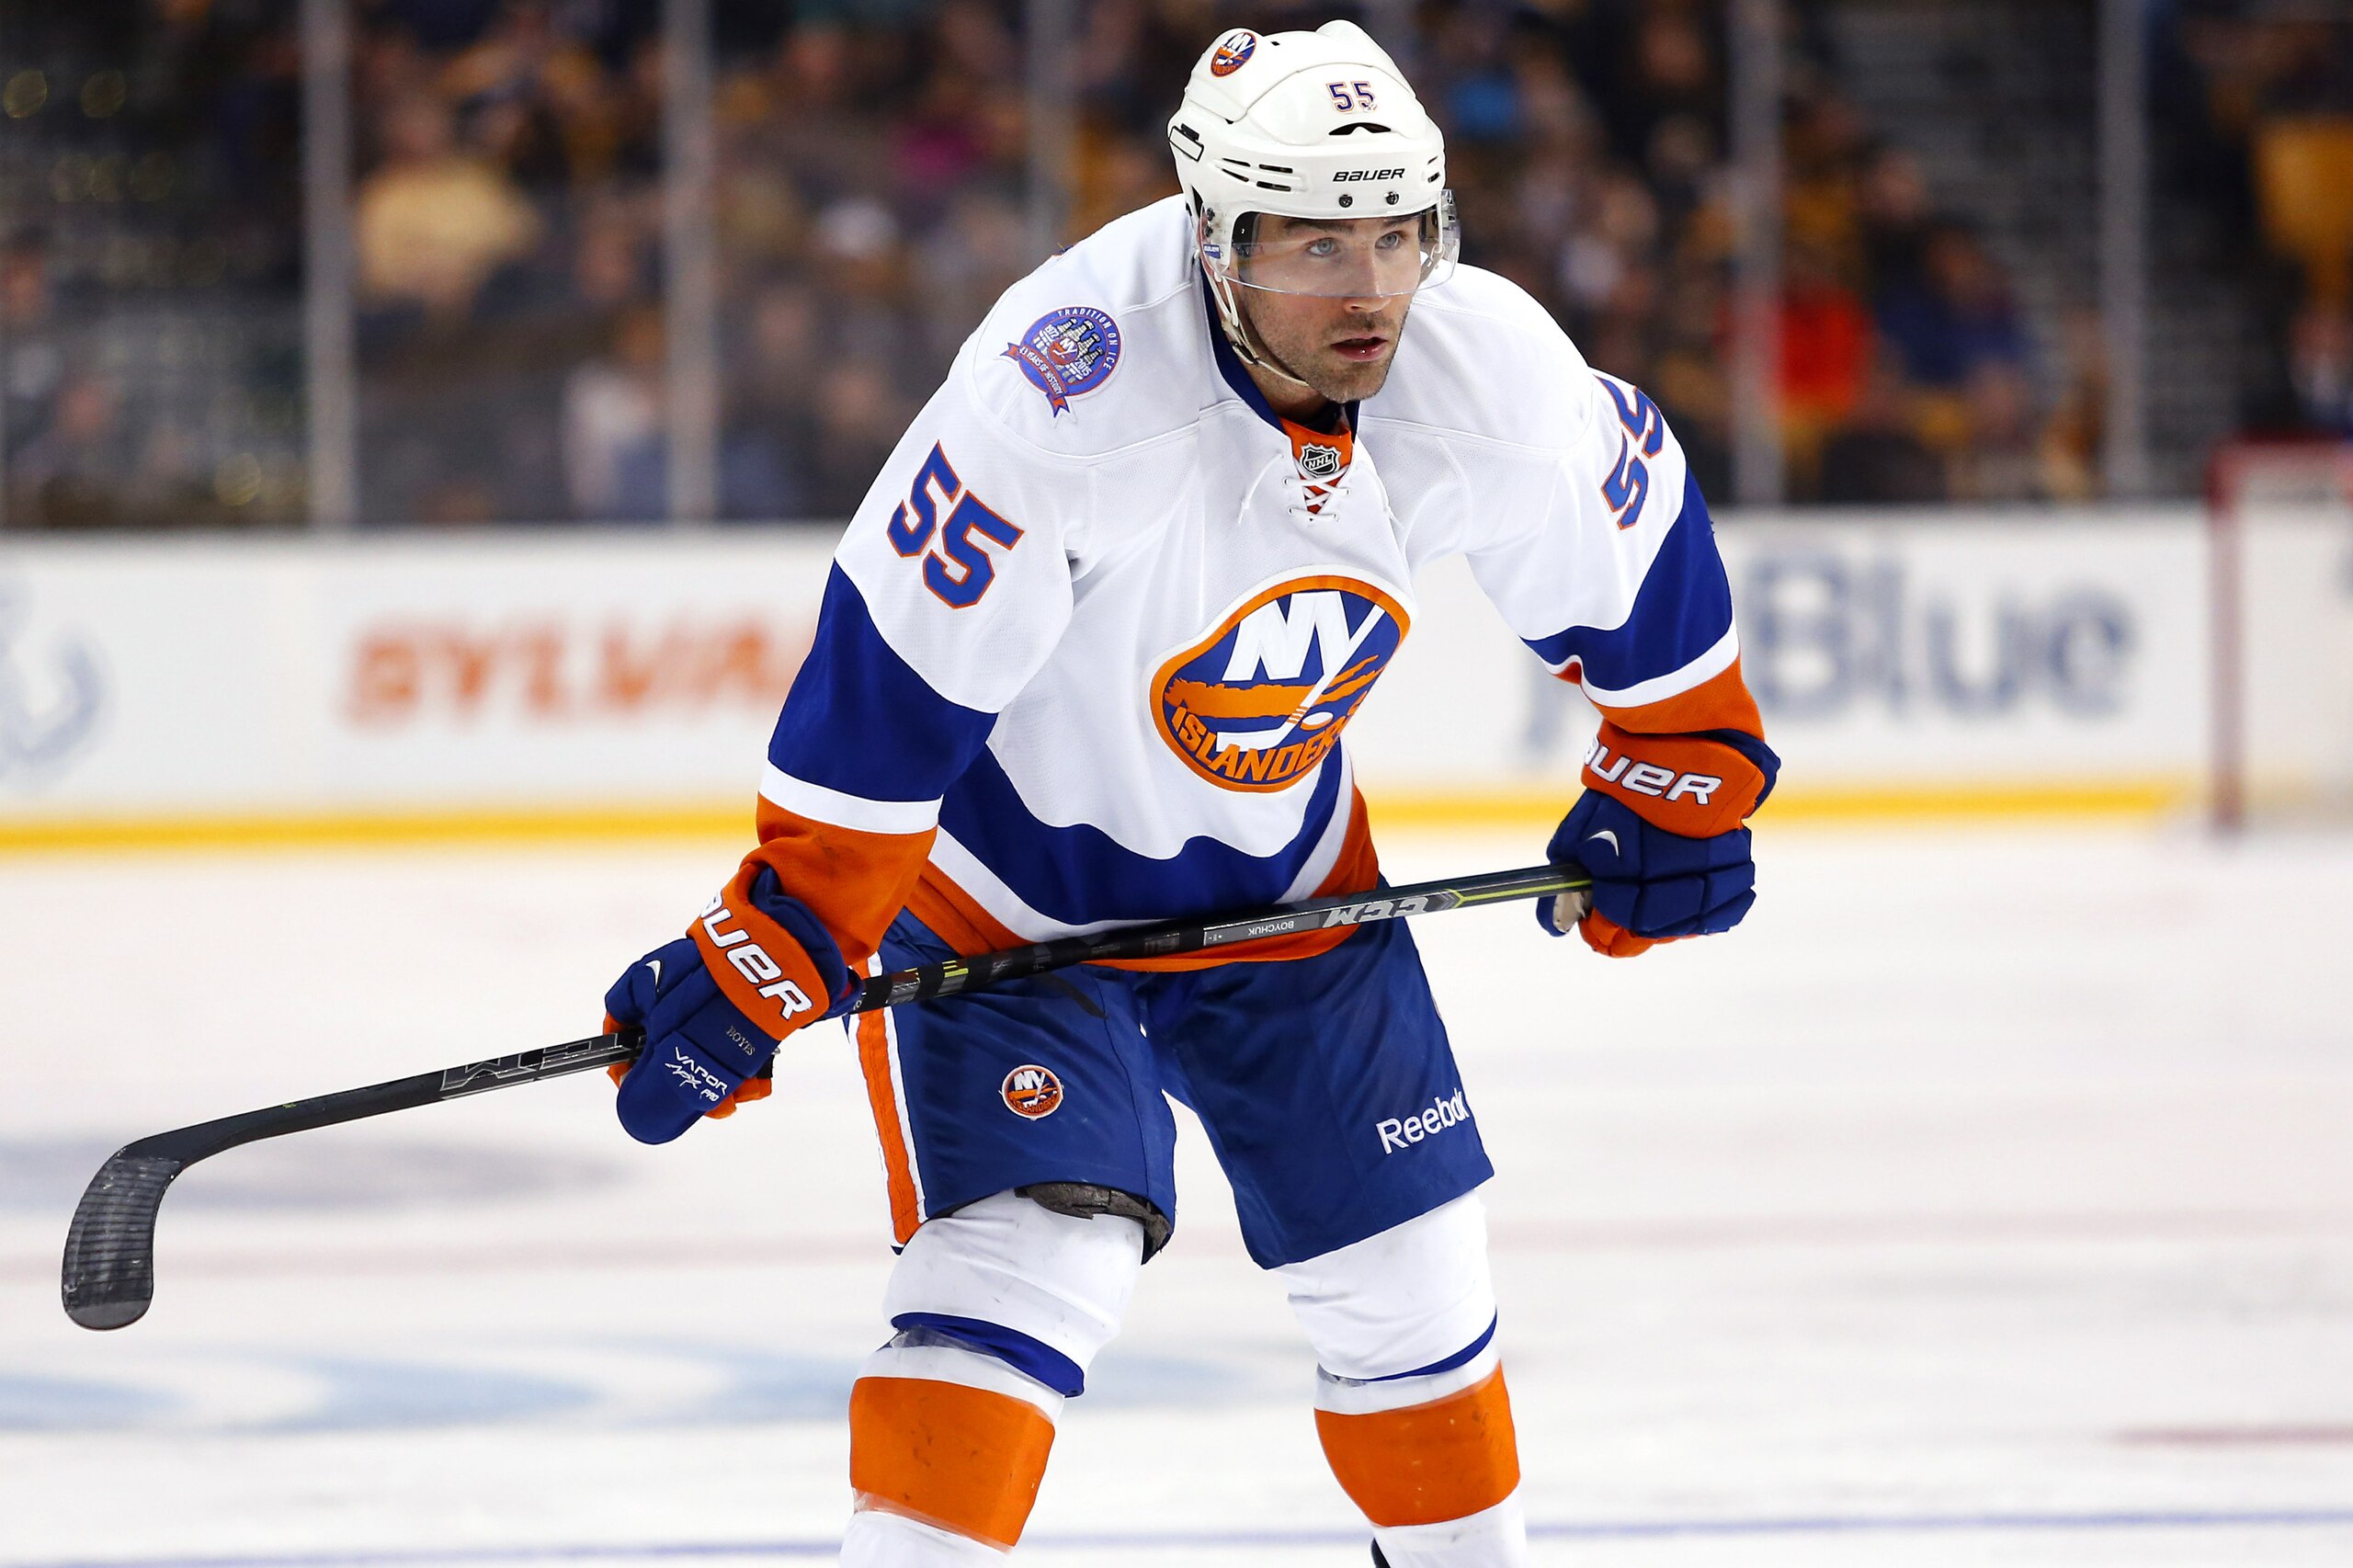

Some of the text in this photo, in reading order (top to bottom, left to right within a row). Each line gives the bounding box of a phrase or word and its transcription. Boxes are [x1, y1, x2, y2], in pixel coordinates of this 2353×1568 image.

[1325, 81, 1378, 112] 55
[1332, 168, 1405, 182] BAUER
[1044, 324, 1060, 339] 1972
[1057, 308, 1119, 370] TRADITION ON ICE
[1027, 351, 1043, 367] YEARS
[1039, 363, 1050, 372] OF
[1074, 358, 1093, 377] 2015
[1044, 370, 1063, 394] HISTORY
[1307, 455, 1333, 470] NHL
[1592, 373, 1664, 530] 55
[887, 438, 1025, 610] 55
[1222, 590, 1386, 682] NY
[1322, 896, 1429, 928] CCM
[1248, 920, 1295, 937] BOYCHUK
[726, 1025, 756, 1056] BOYES
[675, 1046, 728, 1096] VAPOR
[699, 1088, 720, 1102] PRO
